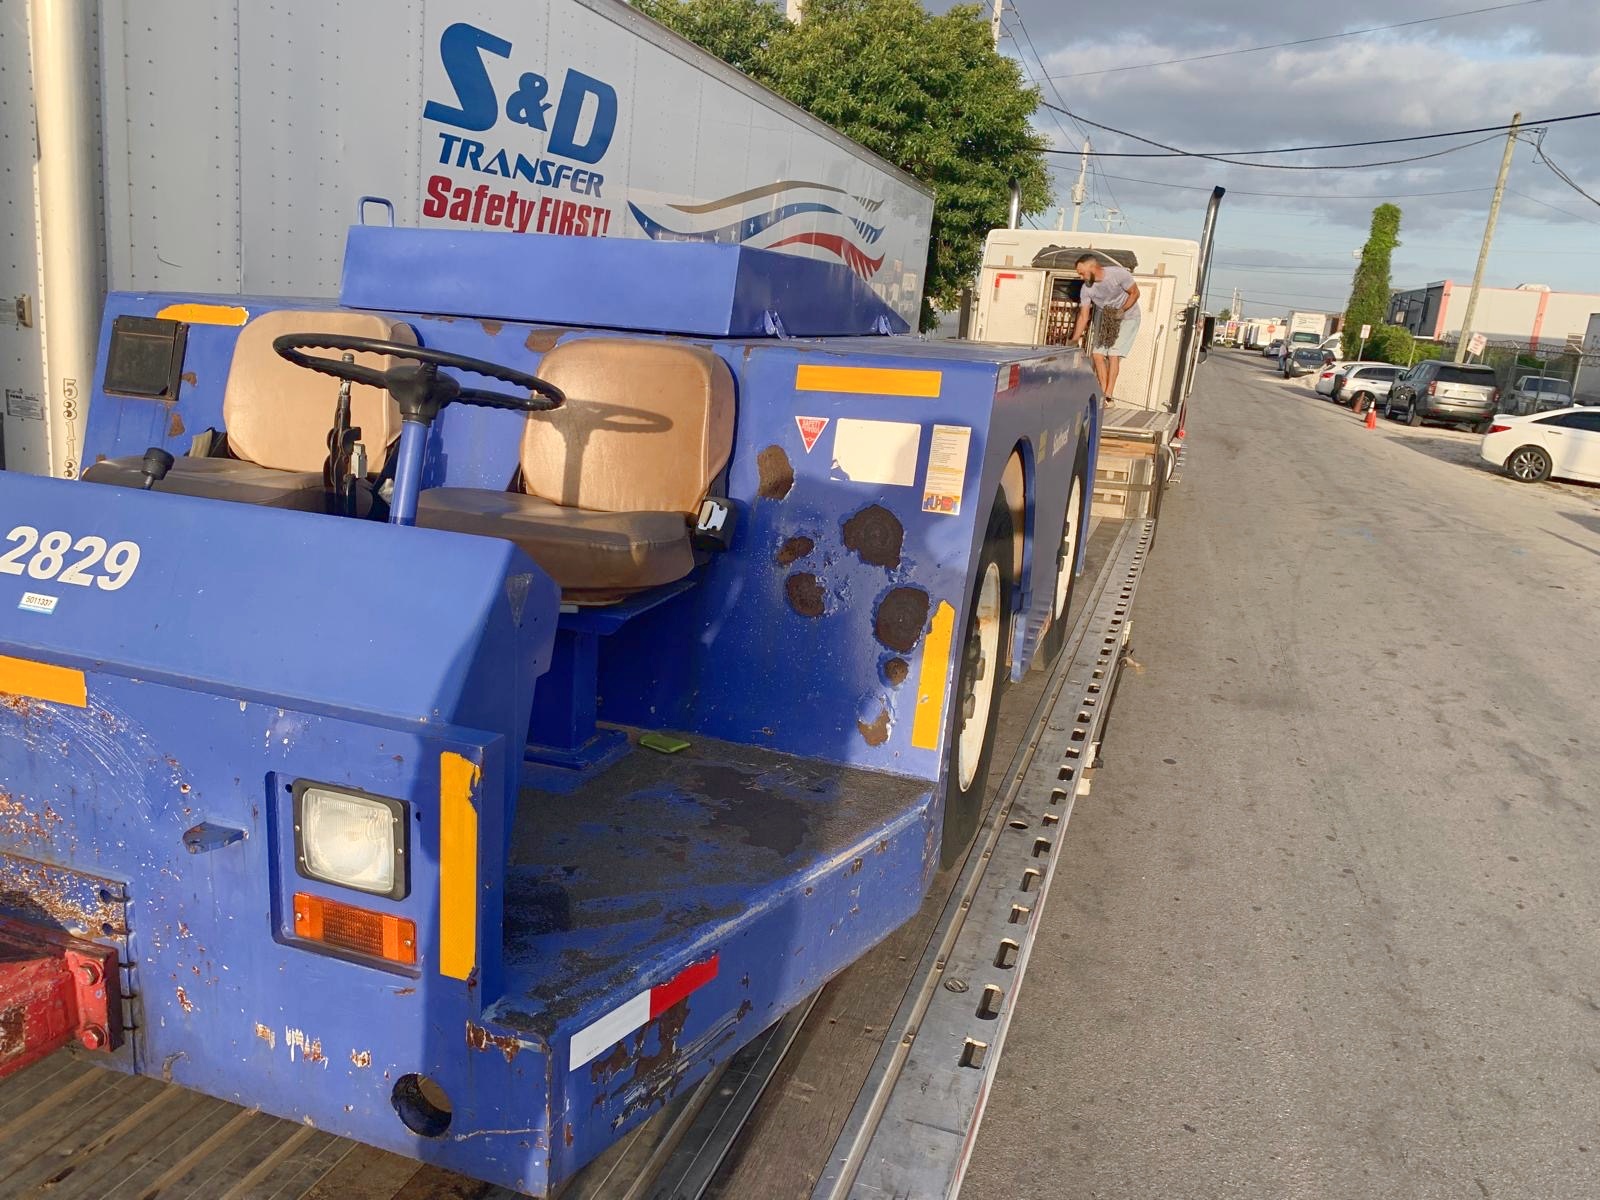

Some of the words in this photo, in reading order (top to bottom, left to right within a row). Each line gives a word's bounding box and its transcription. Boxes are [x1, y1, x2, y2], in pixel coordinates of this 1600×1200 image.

[423, 22, 618, 164] S&D
[439, 132, 604, 198] TRANSFER
[423, 175, 535, 233] Safety
[536, 196, 611, 237] FIRST!
[0, 525, 141, 591] 2829
[25, 595, 53, 607] 5011337
